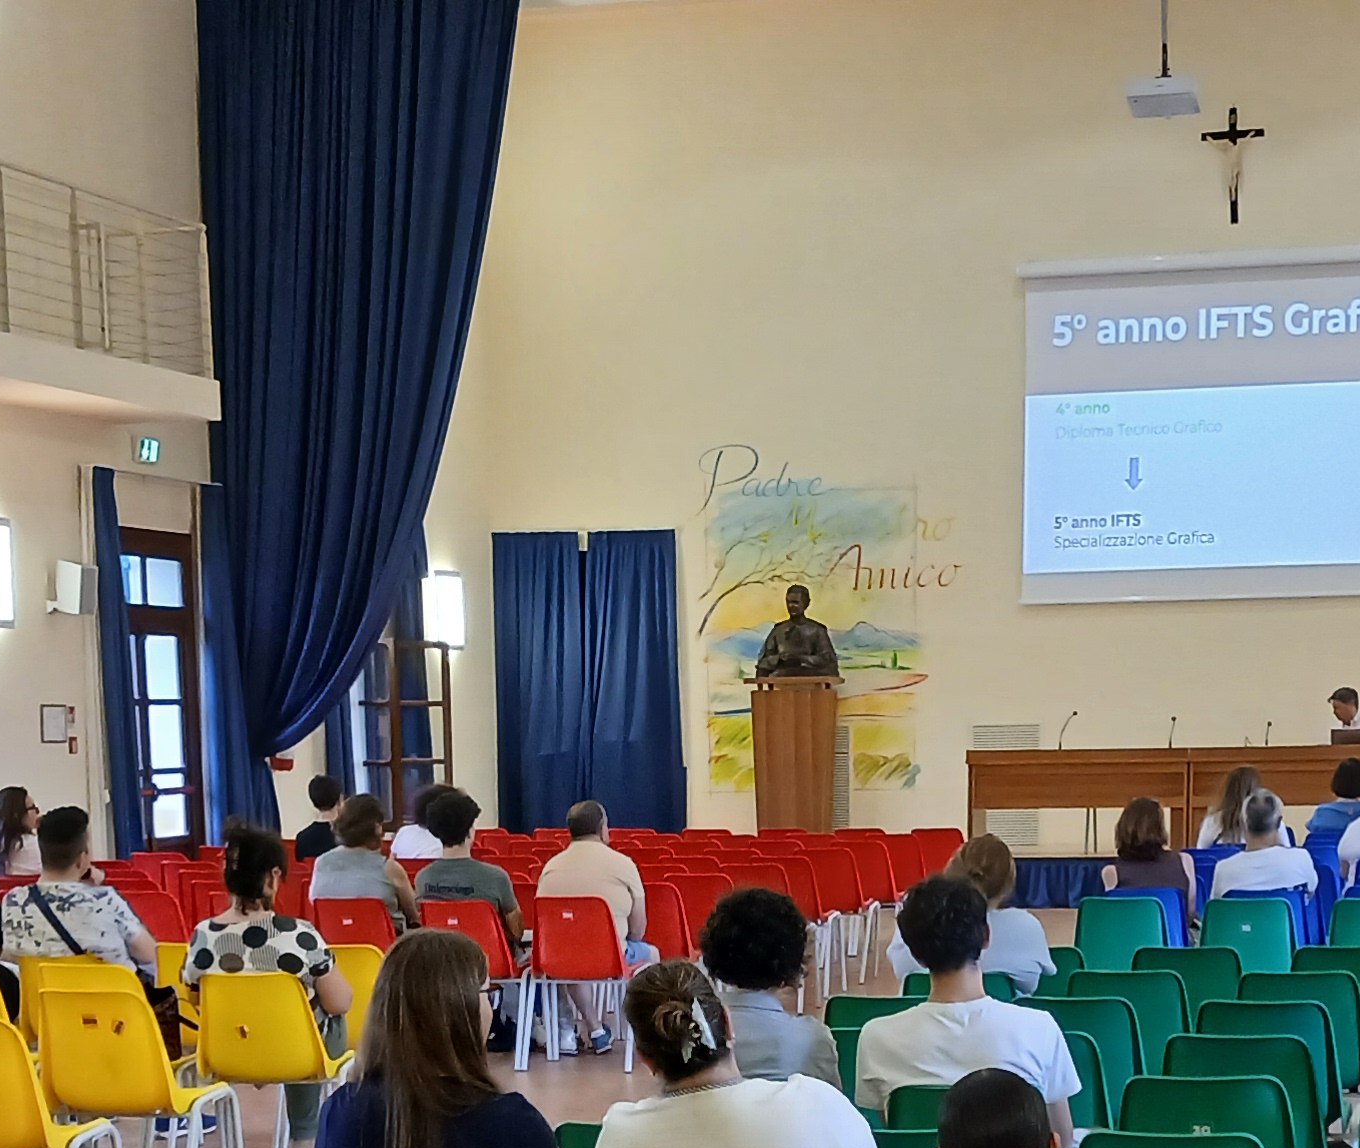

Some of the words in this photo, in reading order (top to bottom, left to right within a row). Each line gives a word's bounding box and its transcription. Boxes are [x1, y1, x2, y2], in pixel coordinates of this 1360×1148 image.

[1096, 314, 1188, 345] anno
[1197, 304, 1274, 340] IFTS
[1074, 403, 1111, 416] anno
[1055, 425, 1114, 440] Diploma
[1117, 422, 1170, 437] Tecnico
[1173, 419, 1223, 435] Grafico
[697, 443, 824, 516] Padre
[1071, 516, 1108, 529] anno
[1110, 513, 1142, 528] IFTS
[1053, 532, 1164, 551] Specializzazione
[1166, 530, 1215, 545] Grafica
[824, 543, 964, 591] Amico
